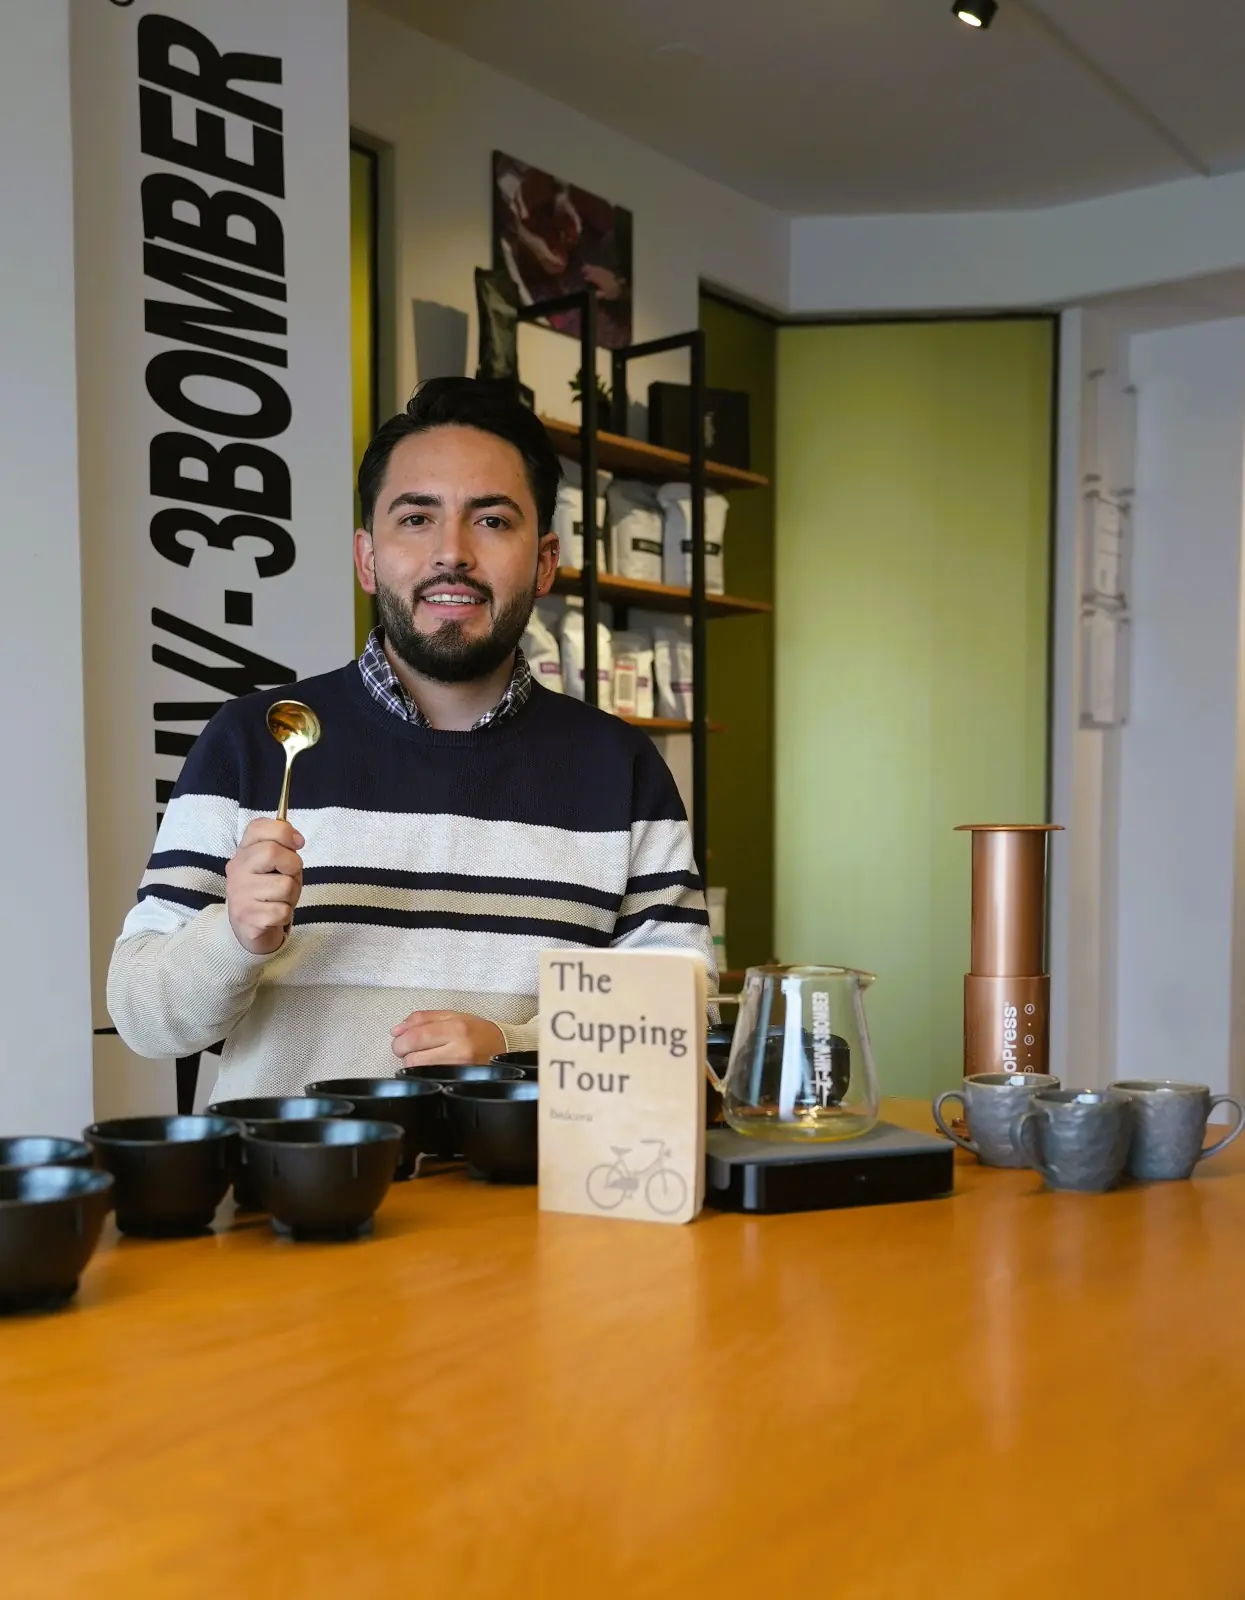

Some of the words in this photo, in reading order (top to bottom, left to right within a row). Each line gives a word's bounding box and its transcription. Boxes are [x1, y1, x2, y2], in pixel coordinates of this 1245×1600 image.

[549, 961, 612, 993] The
[550, 1010, 688, 1057] Cupping
[549, 1060, 630, 1093] Tour
